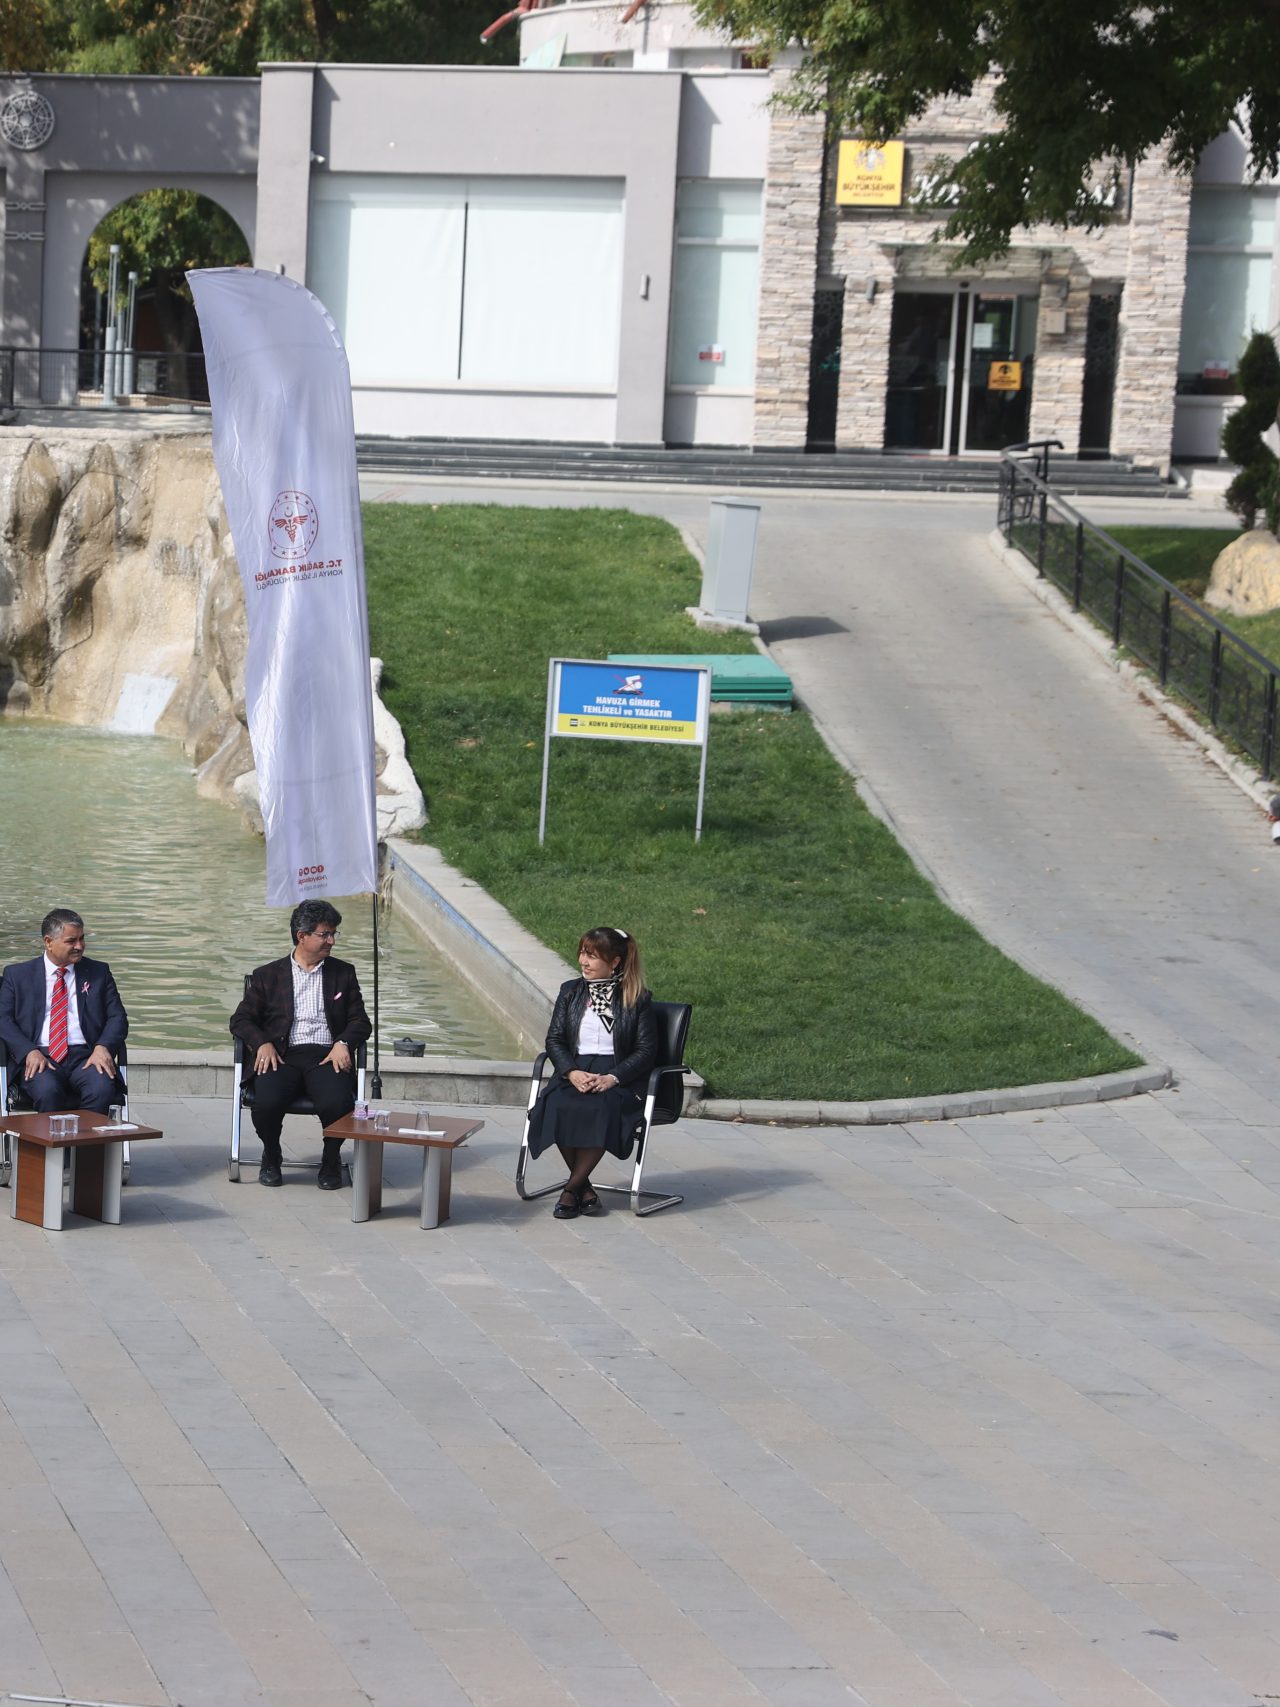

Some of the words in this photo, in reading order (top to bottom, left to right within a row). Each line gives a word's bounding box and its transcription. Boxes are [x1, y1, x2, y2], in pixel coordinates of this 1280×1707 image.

[596, 696, 627, 706] HAVUZA
[629, 697, 661, 707] GİRMEK
[583, 705, 622, 715] TEHLİKELİ
[635, 708, 672, 718] YASAKTIR
[610, 721, 648, 731] BÜYÜKŞEHİR
[649, 724, 684, 732] BELEDİYESİ
